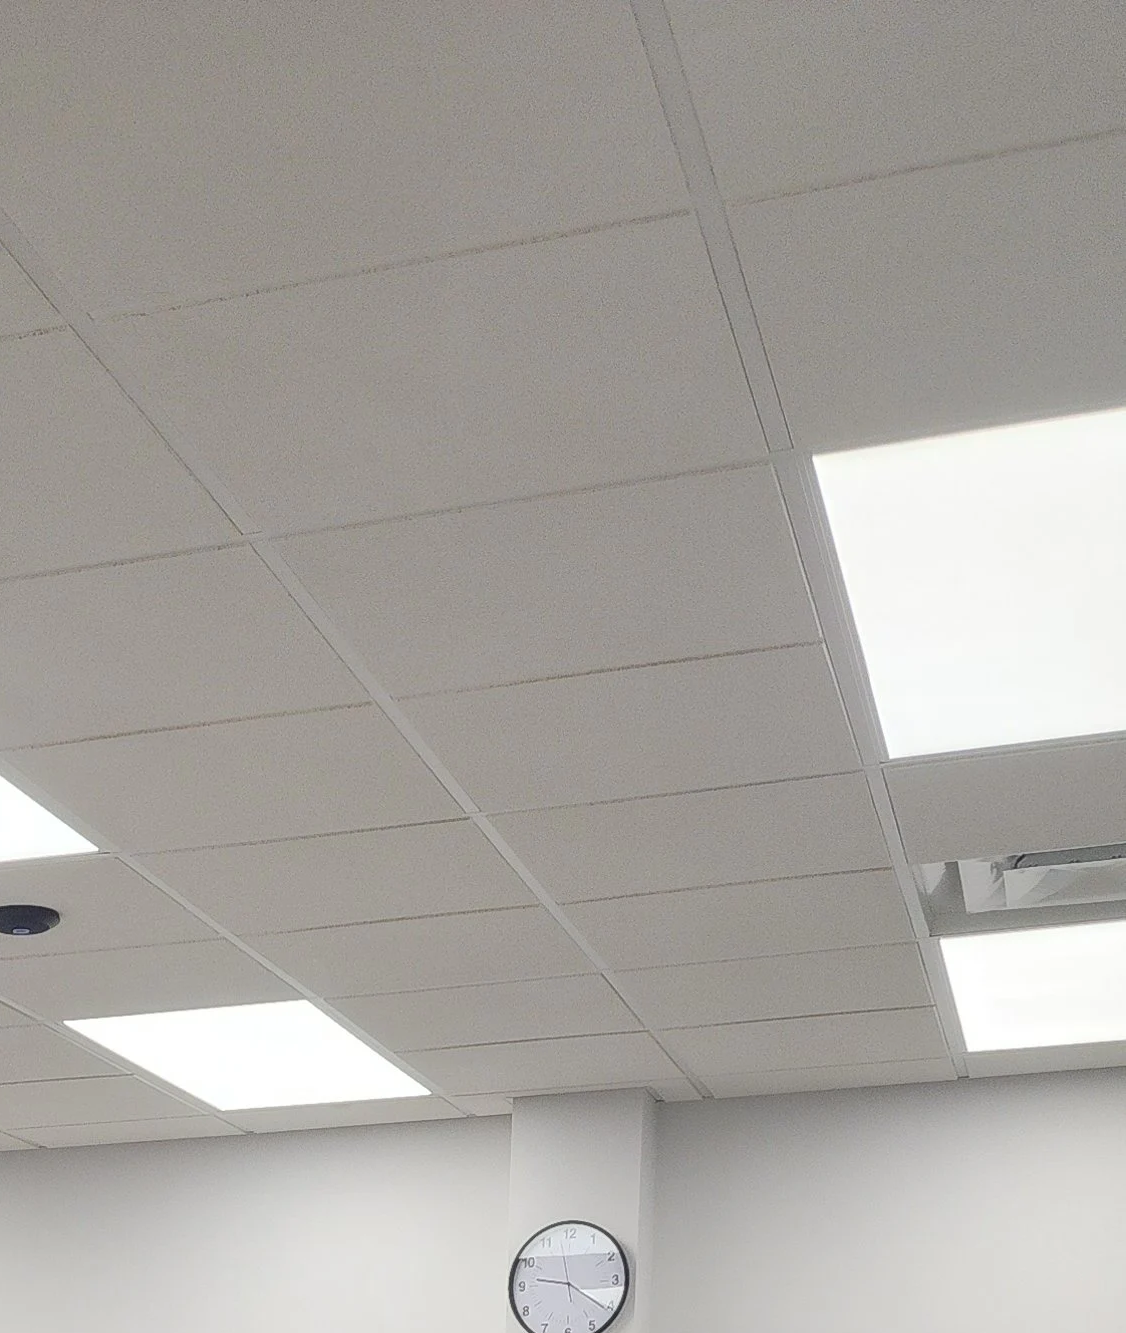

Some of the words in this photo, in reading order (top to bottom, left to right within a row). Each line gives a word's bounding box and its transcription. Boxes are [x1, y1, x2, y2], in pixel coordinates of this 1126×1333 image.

[564, 1228, 576, 1239] 12
[590, 1233, 595, 1244] 1
[540, 1237, 552, 1248] 11
[607, 1252, 615, 1261] 2
[523, 1257, 535, 1268] 10
[612, 1274, 619, 1285] 3
[518, 1281, 526, 1292] 9
[522, 1306, 530, 1316] 8
[541, 1323, 548, 1333] 7
[588, 1320, 595, 1331] 5
